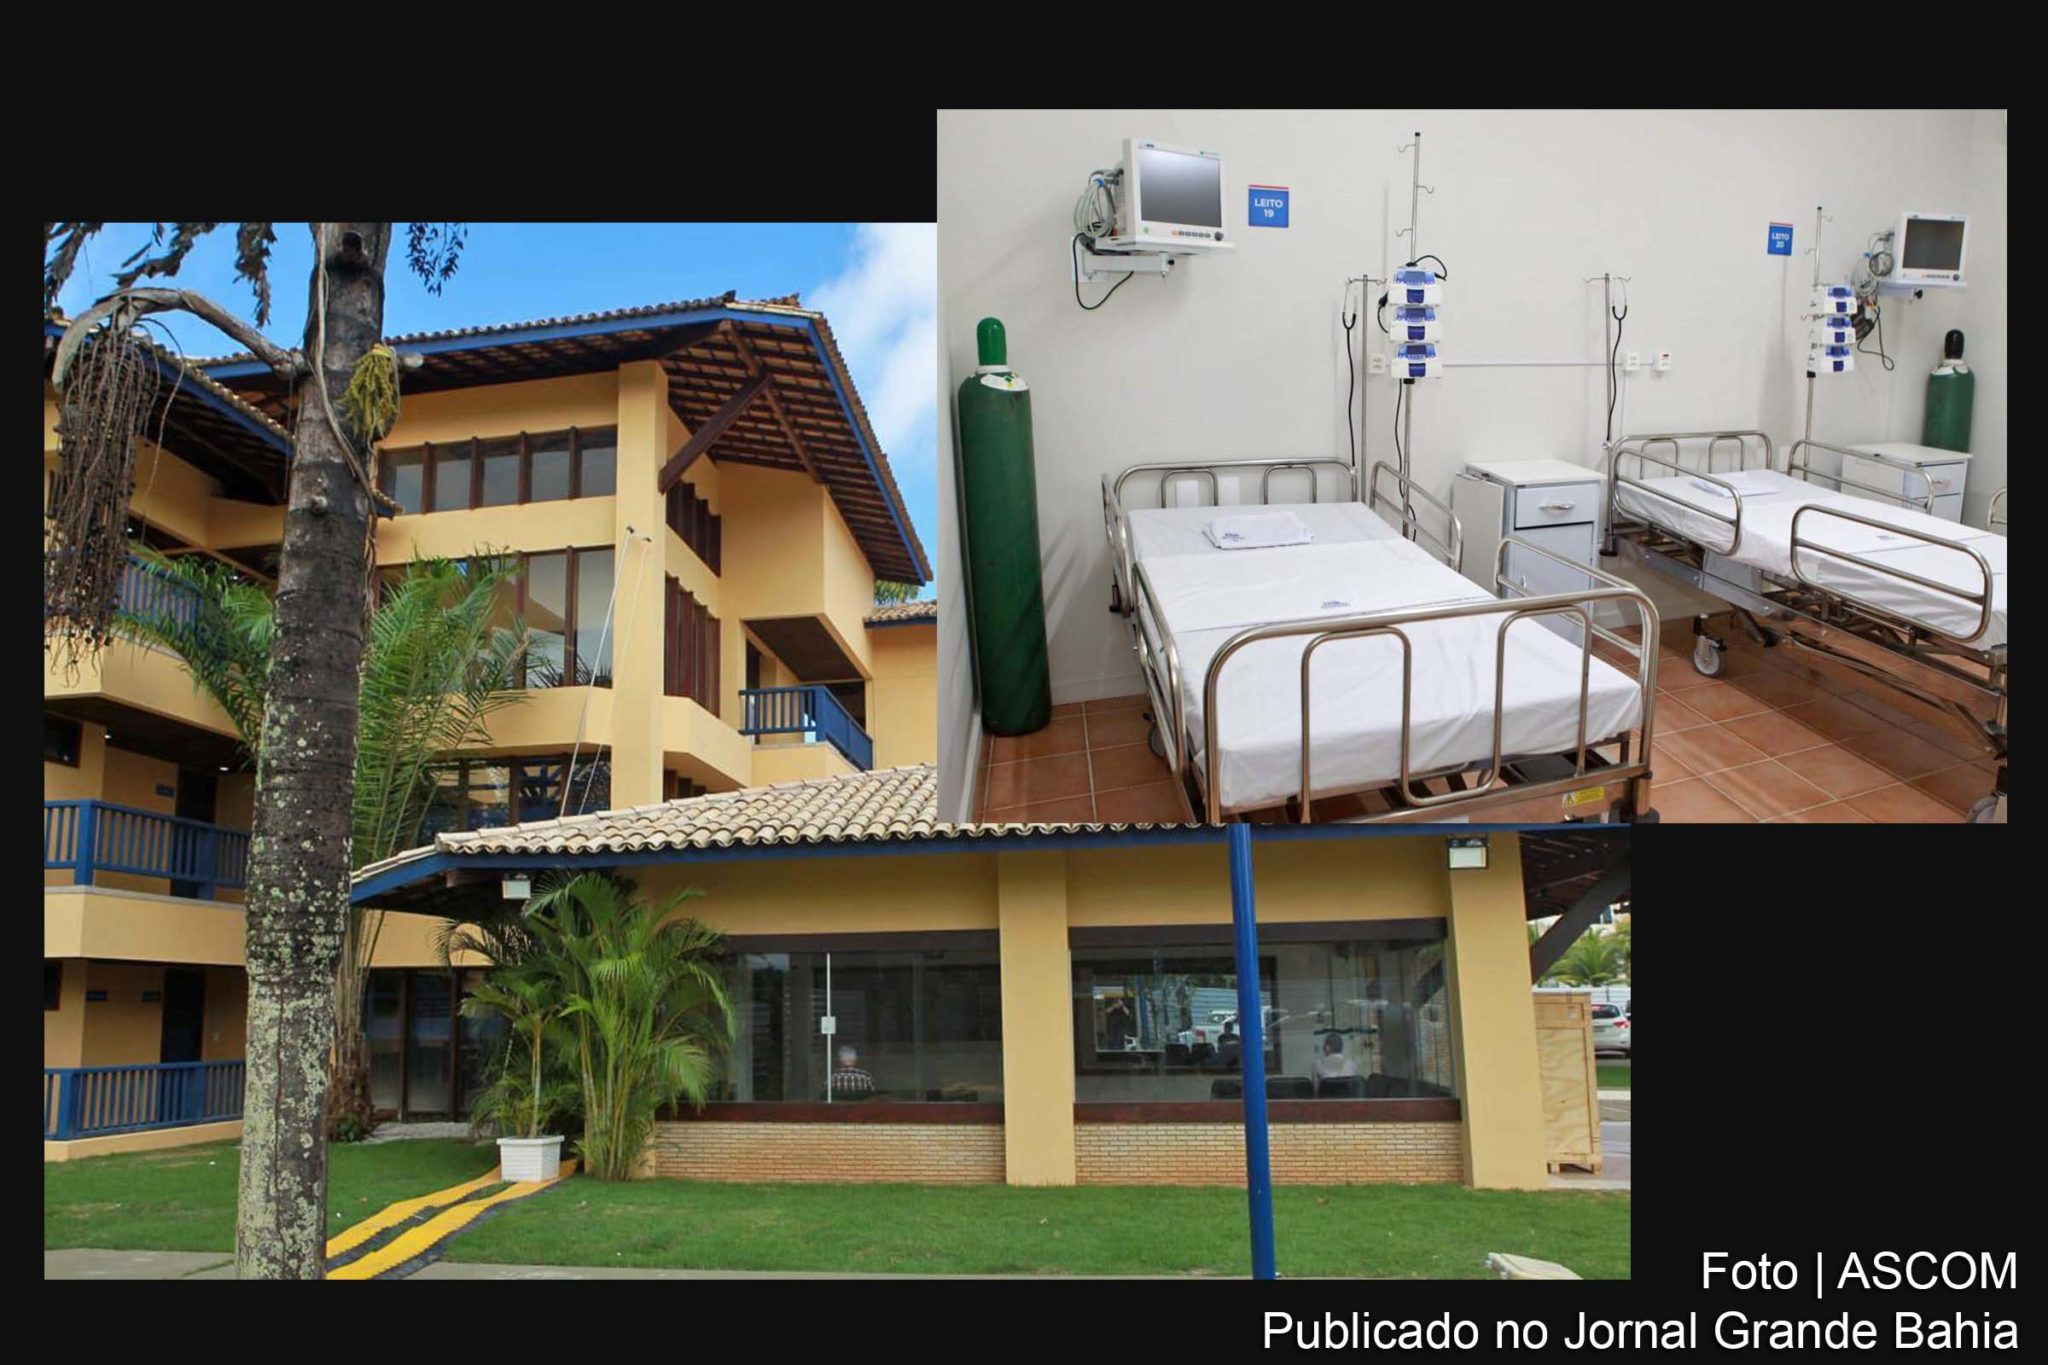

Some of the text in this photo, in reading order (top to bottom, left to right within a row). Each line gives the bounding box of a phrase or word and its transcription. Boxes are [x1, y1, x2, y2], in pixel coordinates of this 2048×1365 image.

[1254, 198, 1283, 208] LEITO
[1263, 209, 1274, 218] 19
[1771, 232, 1790, 241] LEITO
